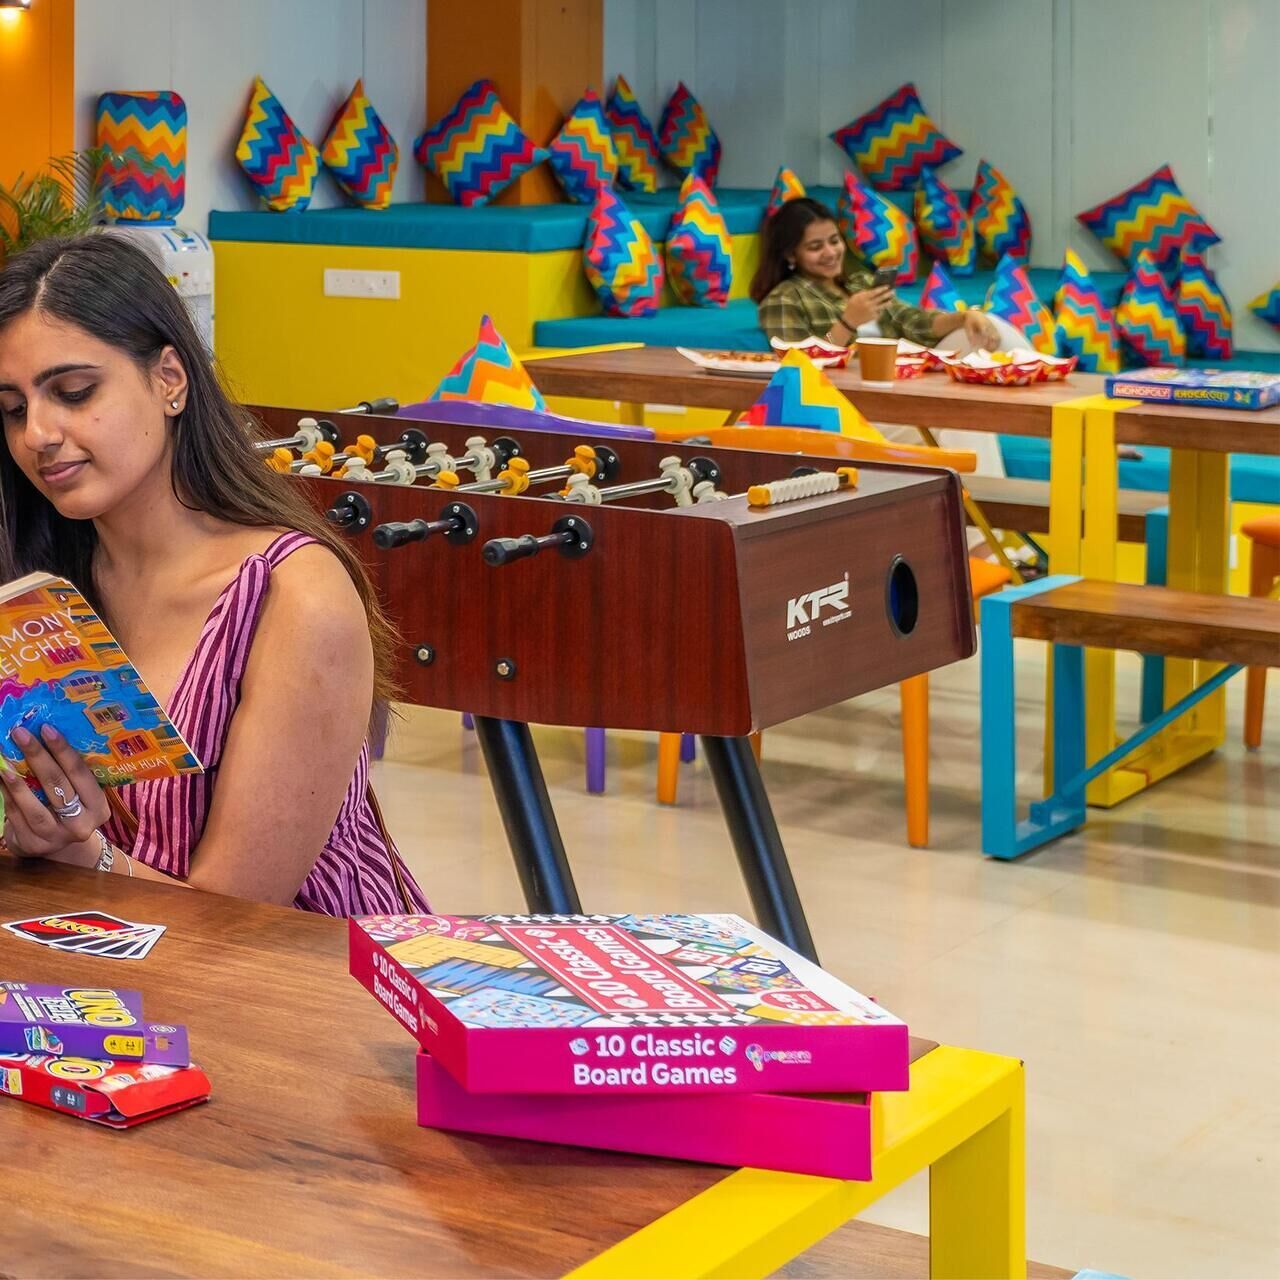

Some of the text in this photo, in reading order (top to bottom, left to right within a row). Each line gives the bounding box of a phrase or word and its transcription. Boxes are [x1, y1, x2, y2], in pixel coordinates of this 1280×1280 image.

[1114, 383, 1170, 399] MONOPOLY
[786, 580, 849, 630] KTR
[107, 762, 138, 776] CHIN
[138, 755, 171, 771] HUAT
[536, 937, 641, 999] 10 Classic
[577, 927, 652, 971] Games
[378, 954, 412, 999] 10 Classic
[619, 968, 708, 1009] Board
[62, 988, 138, 1028] UNO
[373, 974, 396, 1016] Board
[393, 996, 418, 1033] Games
[595, 1033, 716, 1057] 10 Classic
[573, 1062, 737, 1086] Board Games
